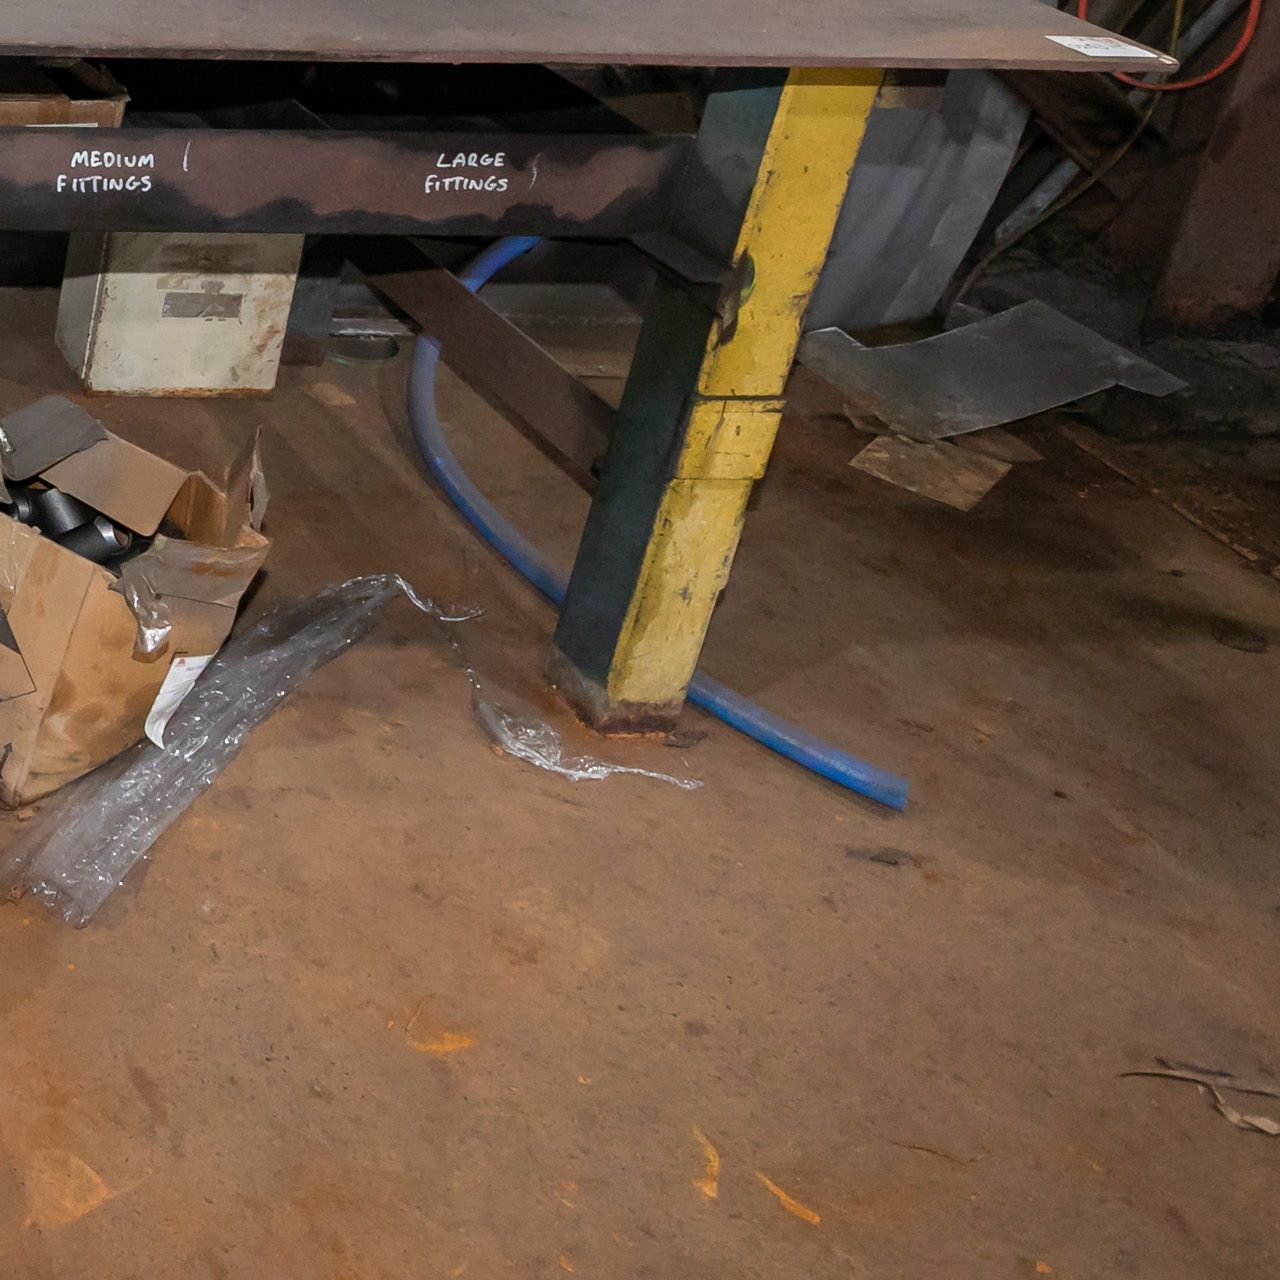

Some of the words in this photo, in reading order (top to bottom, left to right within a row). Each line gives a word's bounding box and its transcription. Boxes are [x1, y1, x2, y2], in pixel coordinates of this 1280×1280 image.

[70, 150, 155, 168] MEDIUM
[436, 152, 505, 168] LARGE
[56, 174, 152, 193] FITTINGS
[425, 174, 509, 193] FITTINGS
